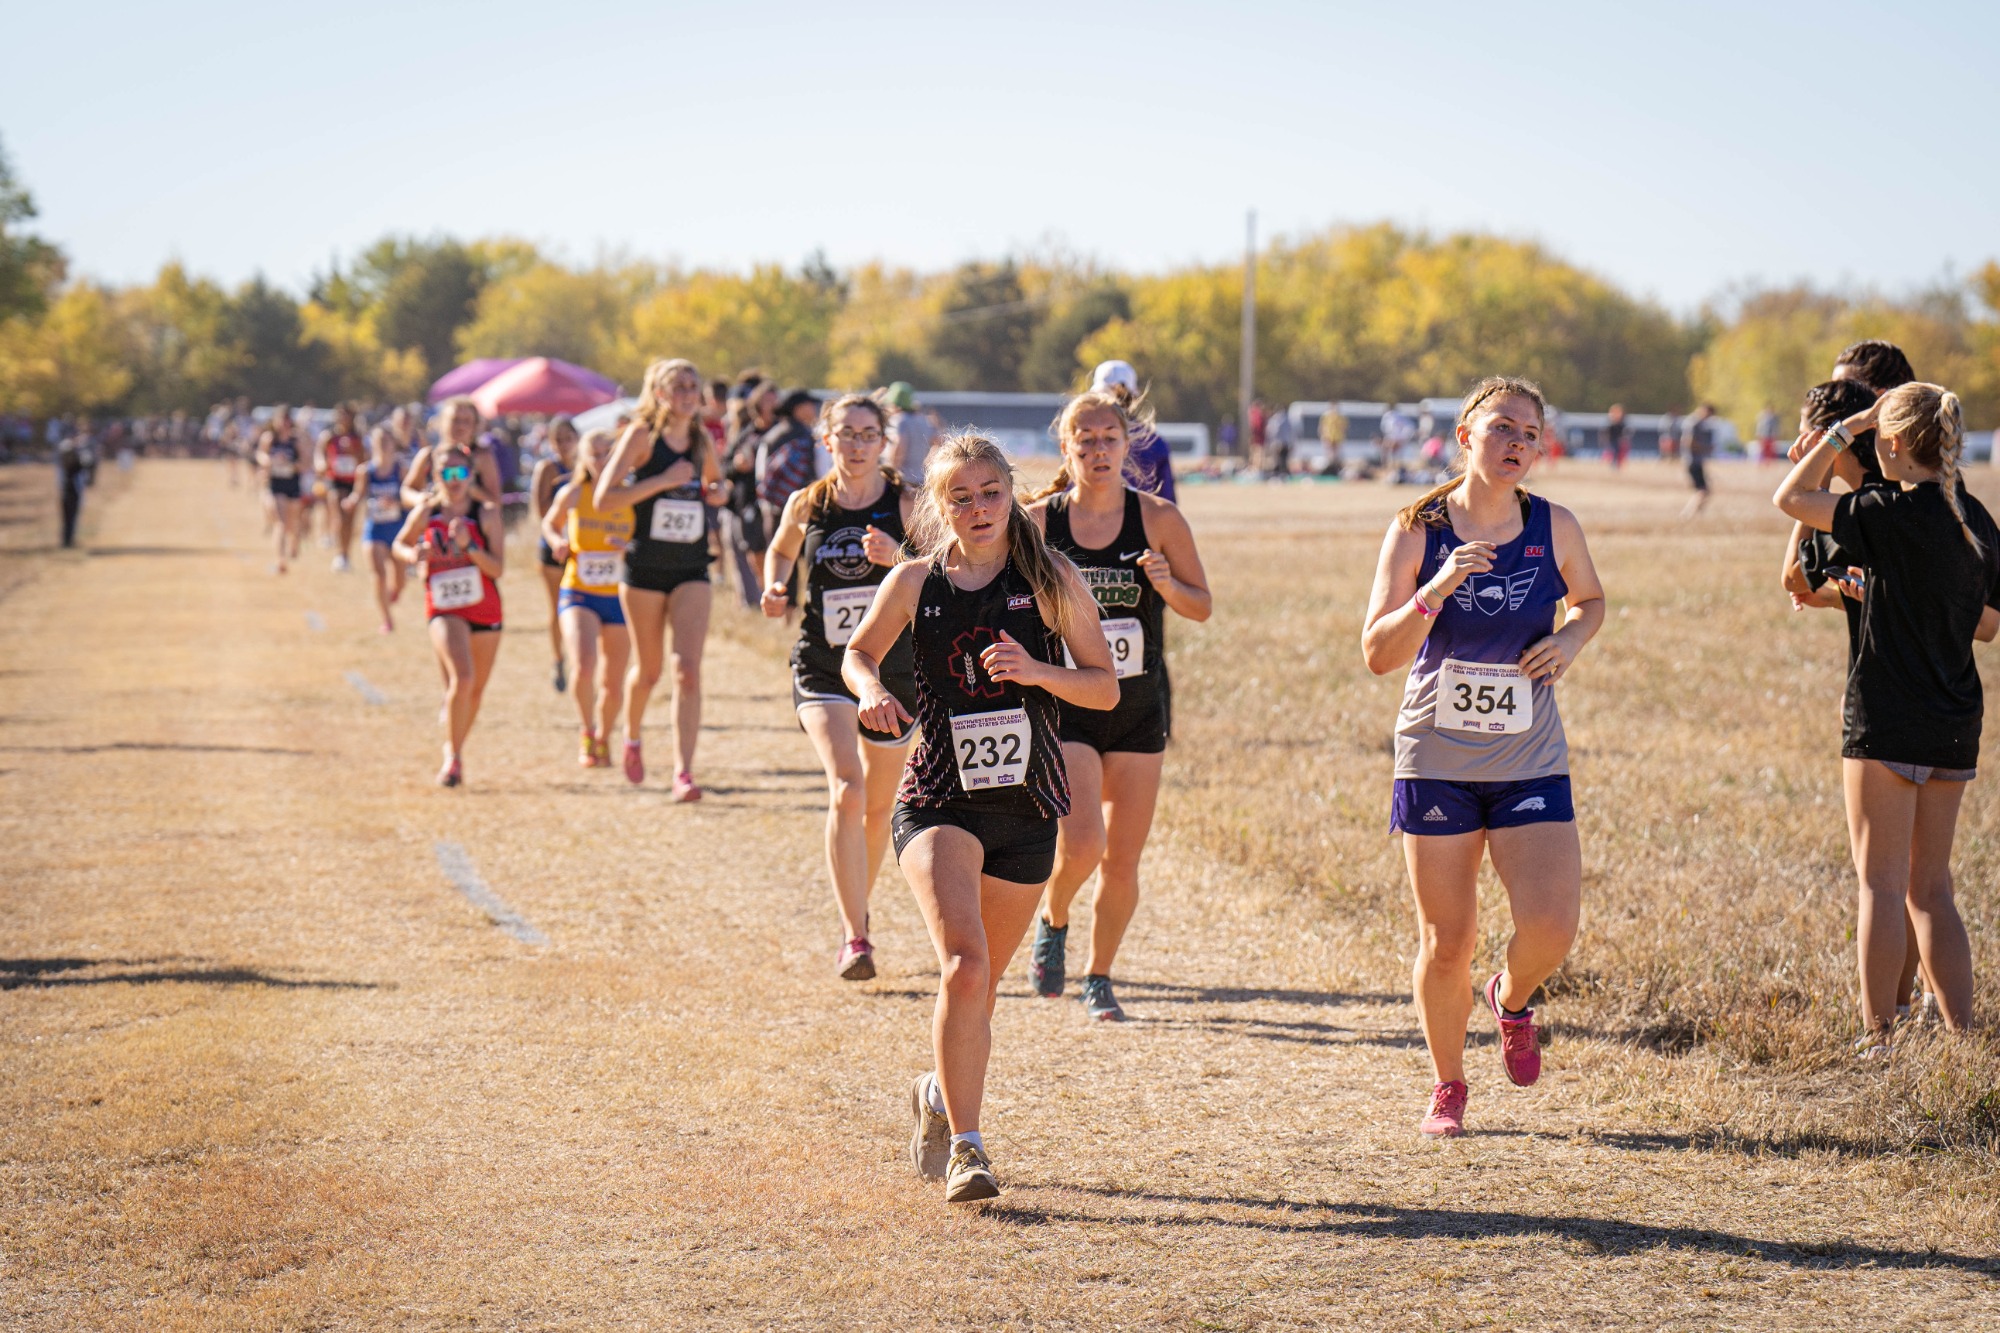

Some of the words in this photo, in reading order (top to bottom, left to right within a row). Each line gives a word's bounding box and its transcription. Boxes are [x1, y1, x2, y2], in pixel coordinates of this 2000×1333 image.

[663, 512, 695, 530] 267
[1082, 568, 1135, 584] LIAM
[439, 578, 473, 598] 282
[1090, 584, 1142, 608] ODS
[836, 605, 867, 630] 27
[1453, 664, 1498, 673] SOUTHWESTERN
[1453, 683, 1516, 715] 354
[953, 716, 997, 727] SOUTHWESTERN
[997, 713, 1022, 721] COLLEGE
[960, 733, 1022, 770] 232
